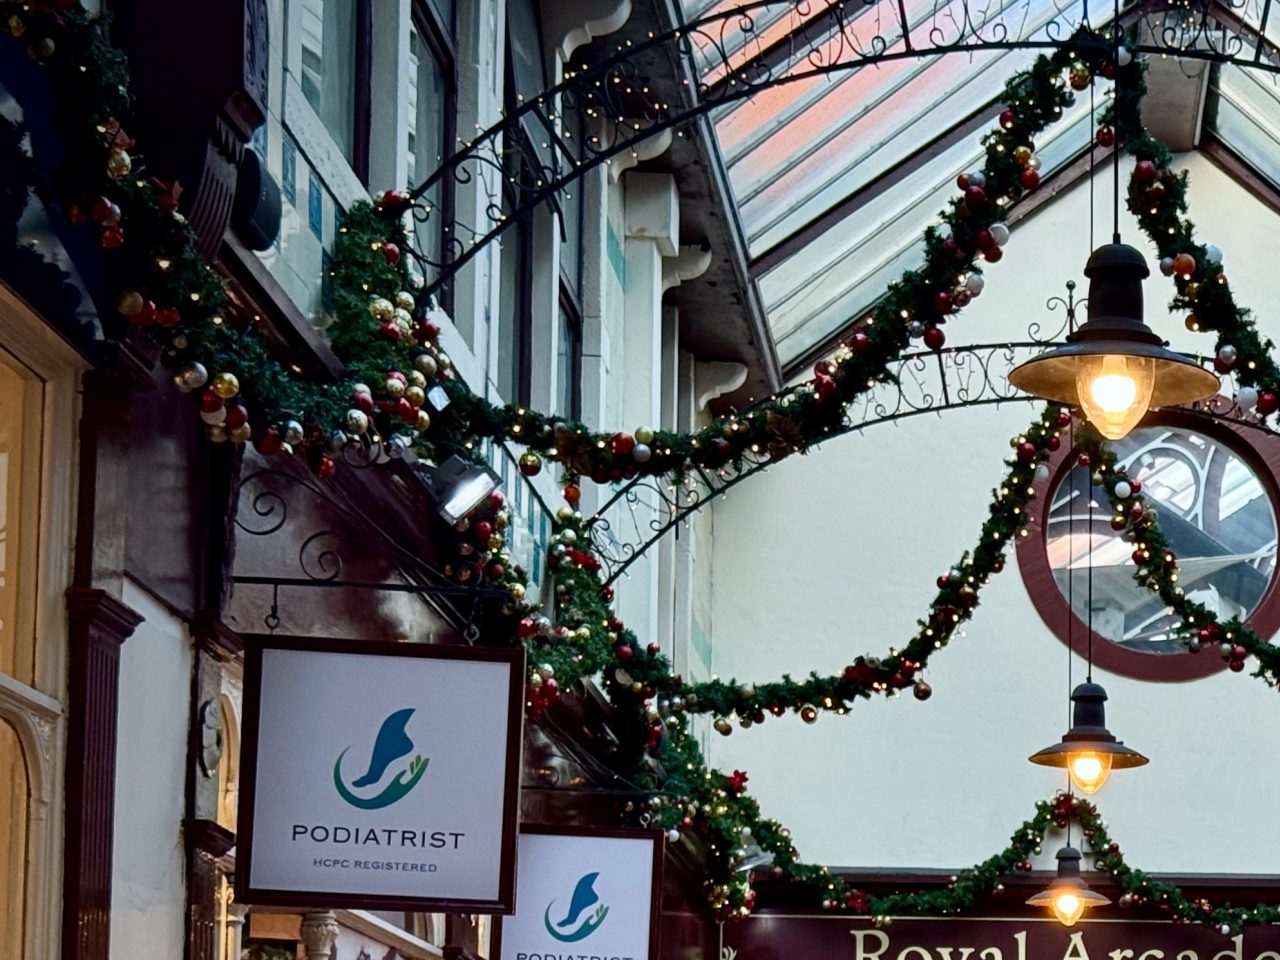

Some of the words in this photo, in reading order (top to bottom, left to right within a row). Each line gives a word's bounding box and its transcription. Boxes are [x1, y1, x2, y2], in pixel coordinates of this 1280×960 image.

[291, 824, 466, 850] PODIATRIST
[312, 858, 350, 869] HCPC
[353, 860, 438, 873] REGISTERED
